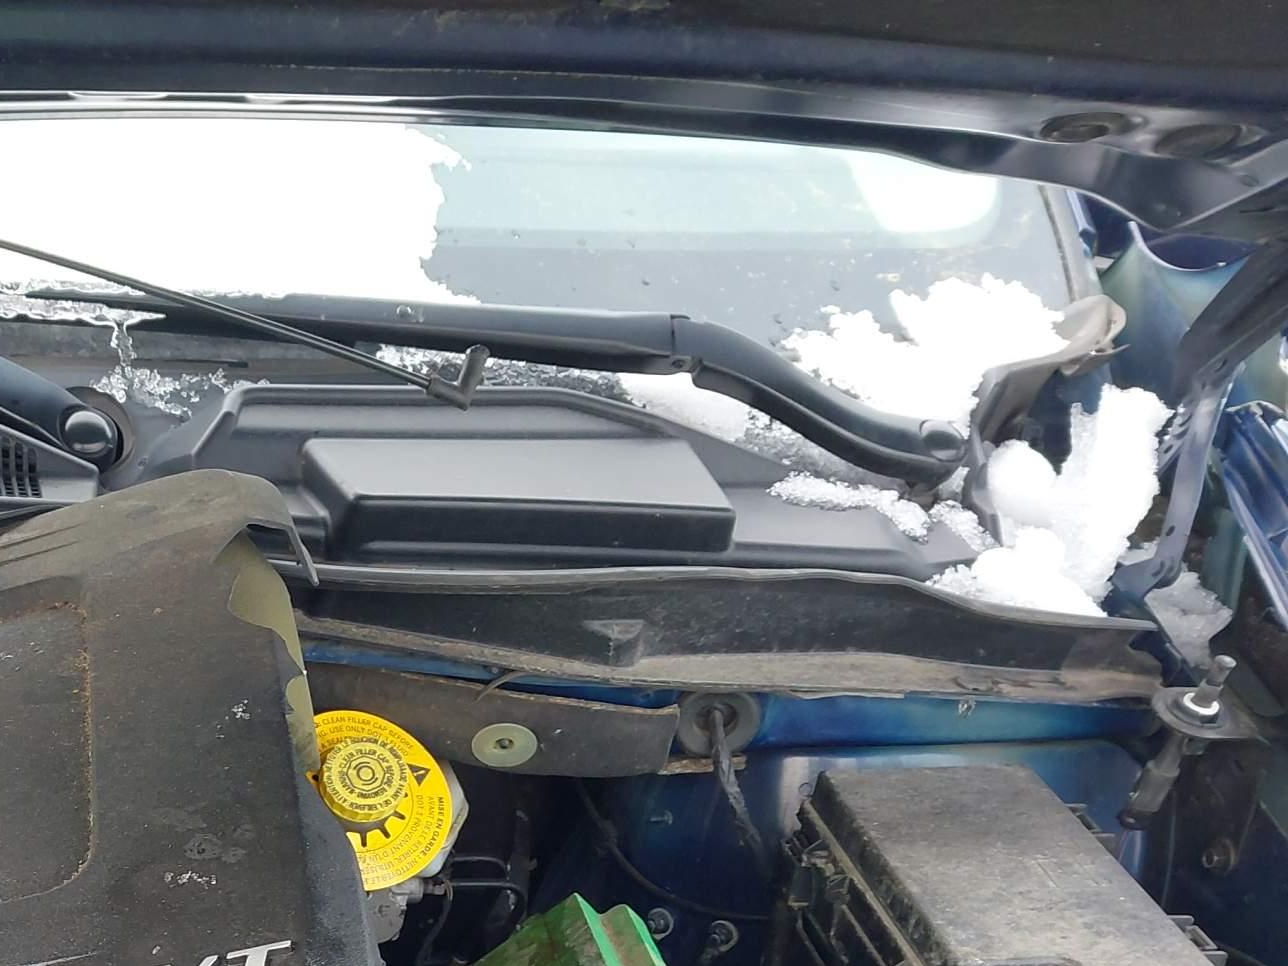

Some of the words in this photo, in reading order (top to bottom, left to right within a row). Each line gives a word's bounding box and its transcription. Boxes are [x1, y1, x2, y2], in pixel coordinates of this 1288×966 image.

[322, 716, 347, 725] CLEAN
[347, 717, 372, 726] FILLER
[372, 721, 388, 731] CAP
[329, 725, 344, 734] USE
[345, 725, 366, 734] ONLY
[437, 796, 445, 817] MISE
[436, 819, 444, 830] EN
